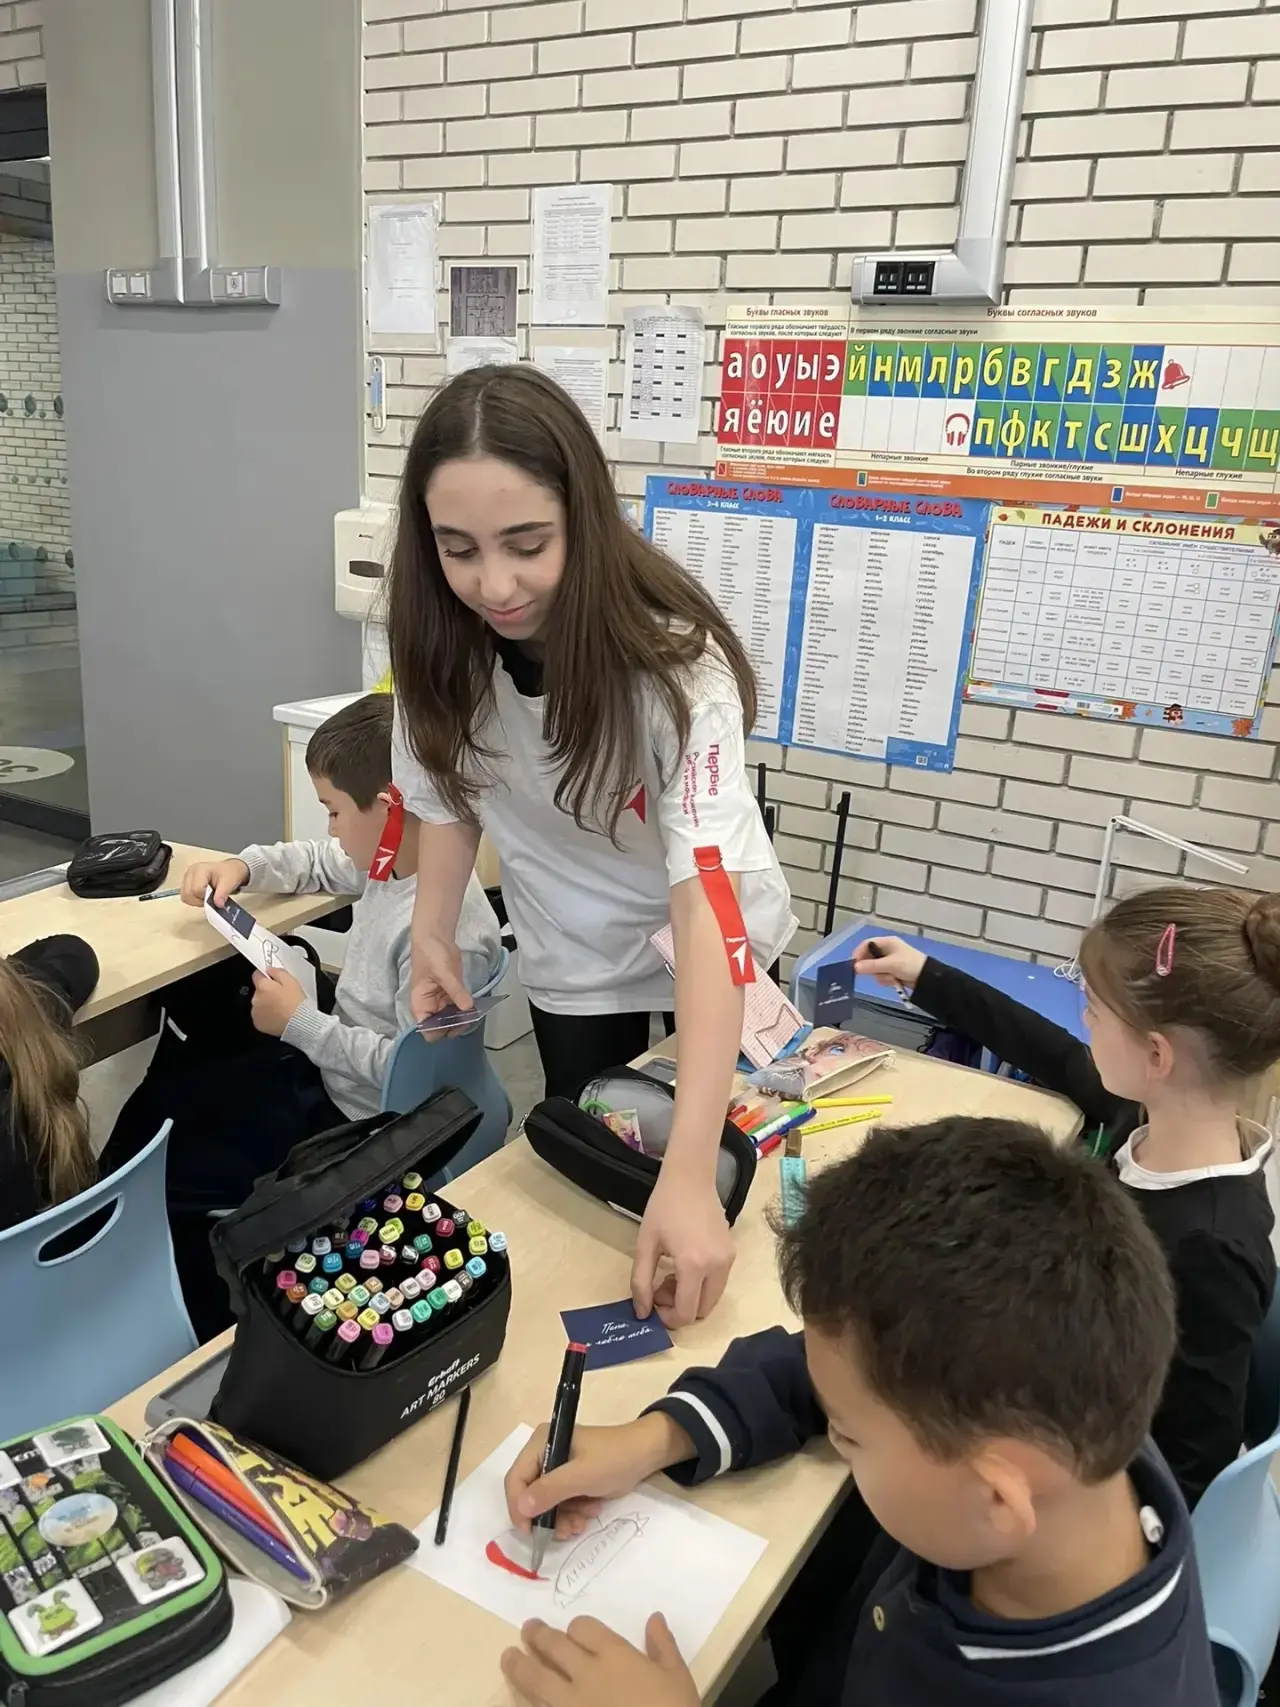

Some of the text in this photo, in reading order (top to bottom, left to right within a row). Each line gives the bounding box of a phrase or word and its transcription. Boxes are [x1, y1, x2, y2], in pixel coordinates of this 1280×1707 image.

[746, 307, 828, 318] Буквы гласных звуков
[986, 308, 1097, 318] Буквы согласных звуков
[880, 328, 896, 336] ряду
[924, 328, 958, 336] согласные
[959, 328, 978, 336] звуки
[870, 453, 902, 462] Непарные
[1010, 460, 1094, 471] Парные звонкие/глухие
[976, 468, 1000, 476] втором
[1002, 470, 1018, 479] ряду
[1020, 472, 1042, 480] глухие
[1044, 472, 1080, 481] согласные
[1082, 474, 1102, 482] звуки
[1175, 468, 1243, 480] Непарные глухие
[889, 516, 911, 524] КЛАСС
[1042, 513, 1236, 540] ПАДЕЖИ И СКЛОНЕНИЯ
[400, 1352, 480, 1420] ART MARKERS
